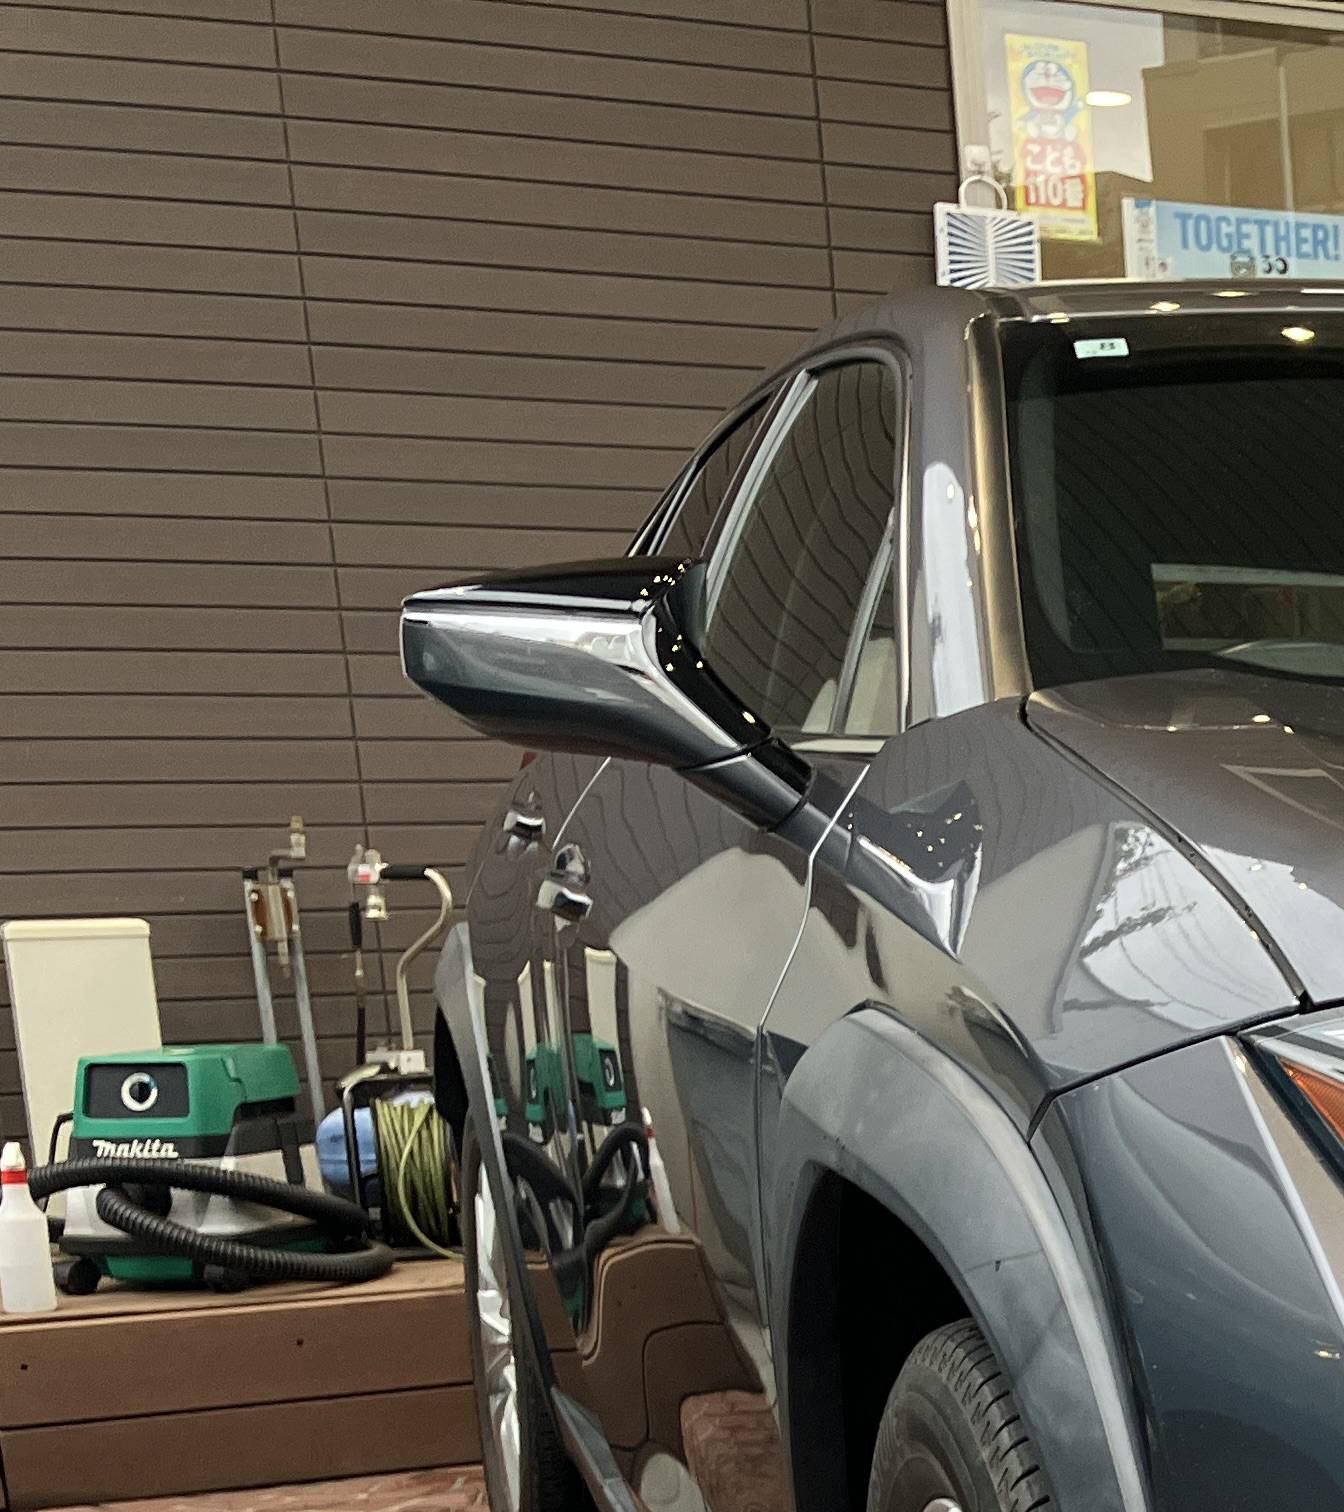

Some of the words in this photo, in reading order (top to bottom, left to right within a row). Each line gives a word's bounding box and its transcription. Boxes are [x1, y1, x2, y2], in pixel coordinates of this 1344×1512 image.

[1026, 144, 1082, 174] こども
[1027, 175, 1084, 208] 110番
[1173, 211, 1342, 261] TOGETHER!
